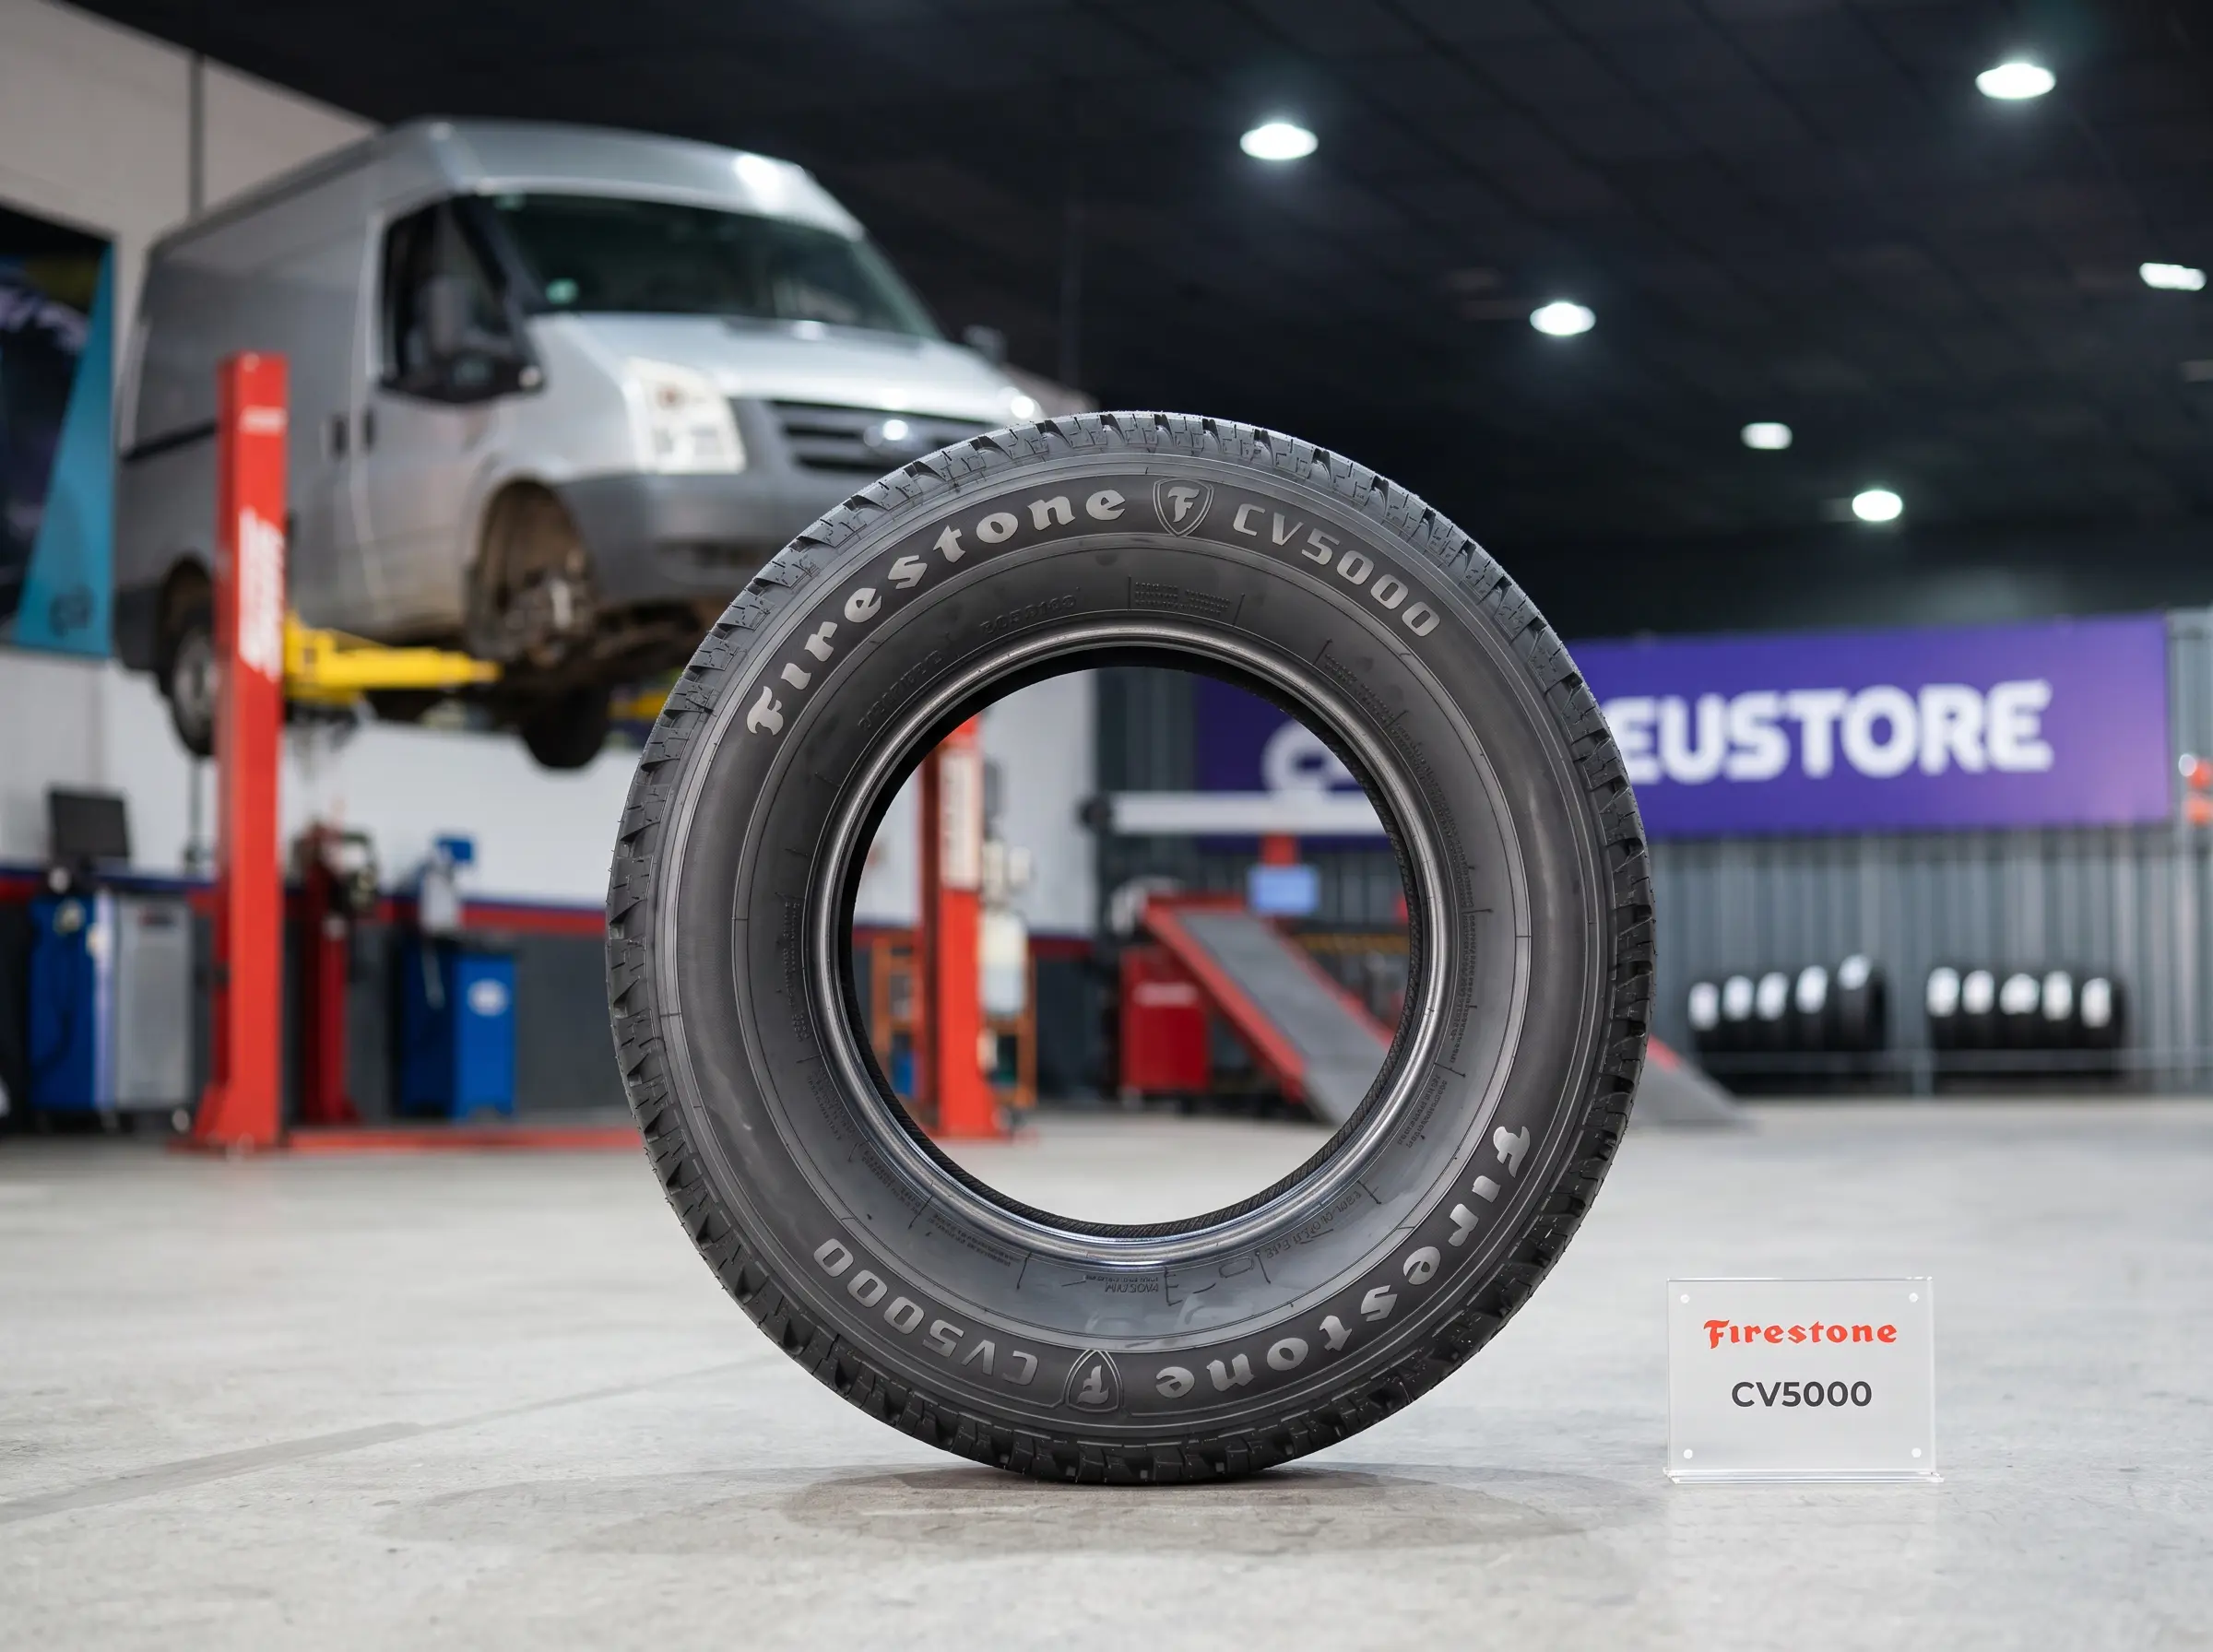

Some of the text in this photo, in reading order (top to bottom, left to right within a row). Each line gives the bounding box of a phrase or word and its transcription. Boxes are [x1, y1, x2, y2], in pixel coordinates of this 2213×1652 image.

[746, 489, 1126, 736] Firestone
[1233, 502, 1440, 638] CV5000
[813, 1238, 1040, 1386] CV5000
[1155, 1126, 1531, 1399] Firestone
[1703, 1319, 1898, 1350] Firestone
[1732, 1381, 1873, 1408] CV5000
